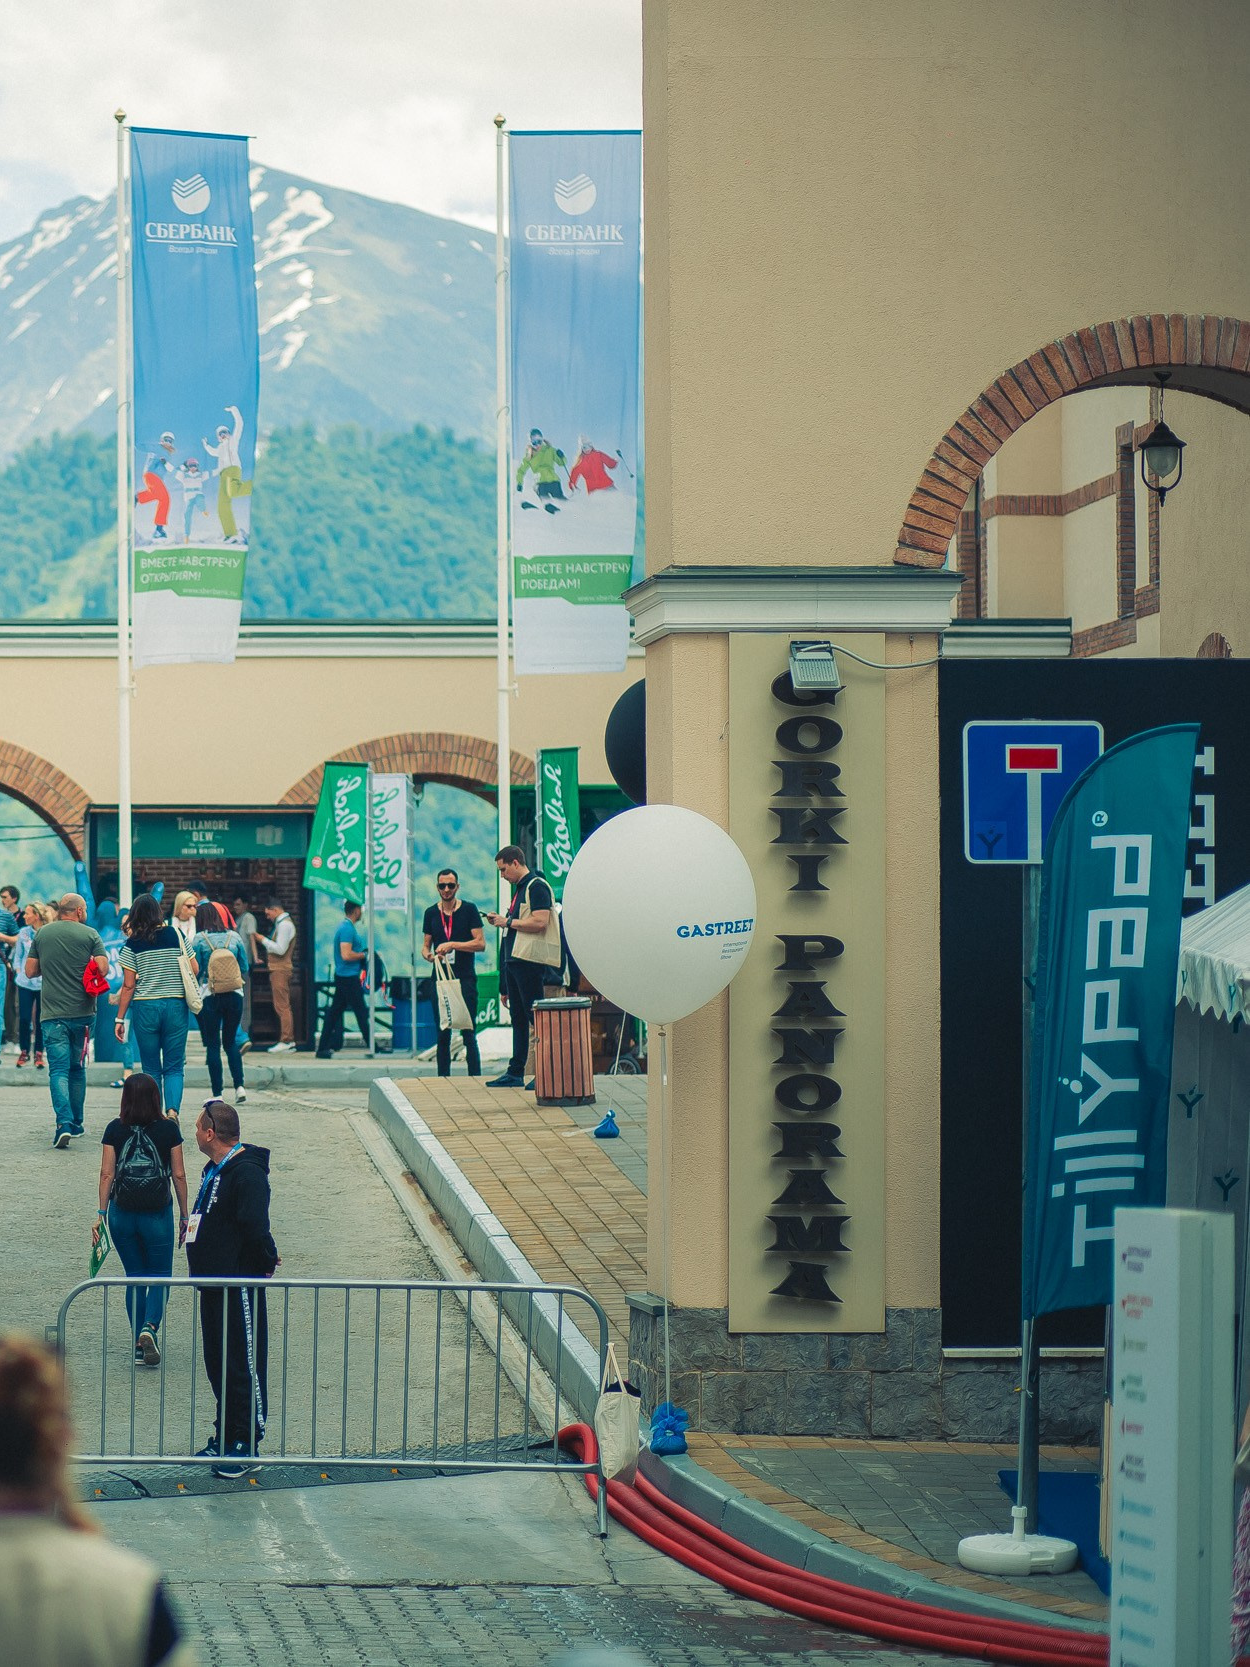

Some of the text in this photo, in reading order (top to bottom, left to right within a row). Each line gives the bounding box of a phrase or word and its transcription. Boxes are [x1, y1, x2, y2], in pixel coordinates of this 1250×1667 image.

[145, 222, 238, 243] СБЕРБАНК
[525, 224, 624, 241] СБЕРБАНК
[140, 556, 241, 569] ВМЕСТЕ НАВСТРЕЧУ
[520, 562, 631, 575] ВМЕСТЕ НАВСТРЕЧУ
[140, 571, 202, 584] ОТКРЫТИЯМ!
[521, 578, 582, 591] ПОБЕДАМ!
[543, 763, 573, 878] Grolsch
[192, 831, 214, 841] DEW
[676, 918, 754, 938] GASTREET
[764, 669, 852, 1303] GORKI PANORAMA
